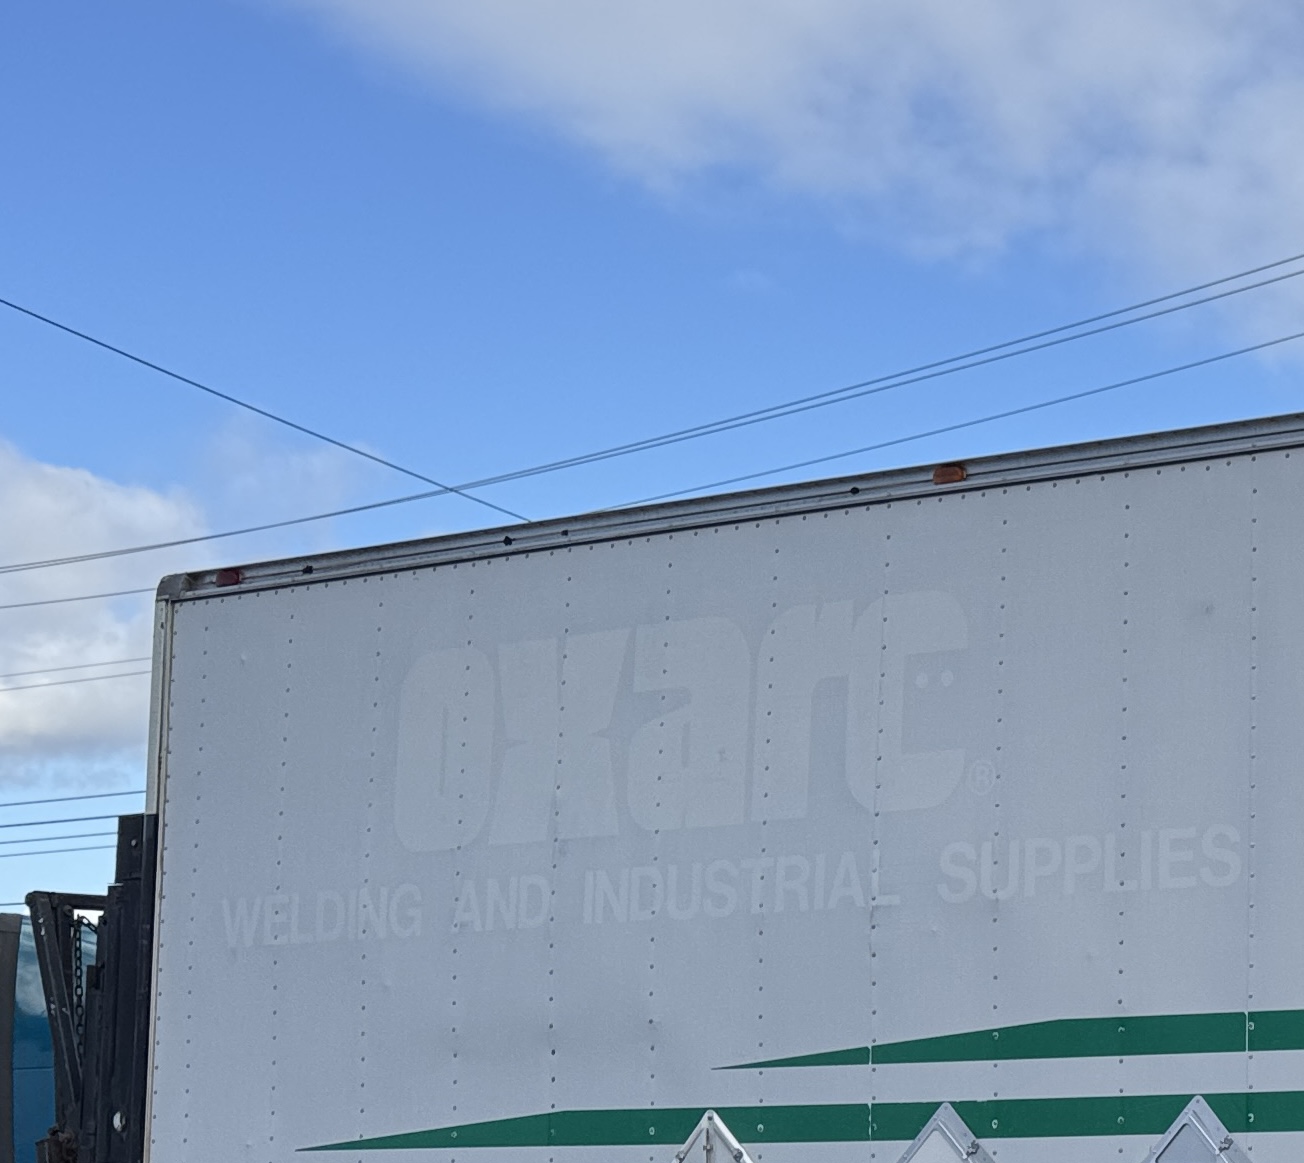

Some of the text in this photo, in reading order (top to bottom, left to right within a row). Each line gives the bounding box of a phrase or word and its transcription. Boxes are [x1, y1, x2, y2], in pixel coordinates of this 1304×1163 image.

[220, 822, 1243, 949] WELDING AND INDUSTRIAL SUPPLIES
